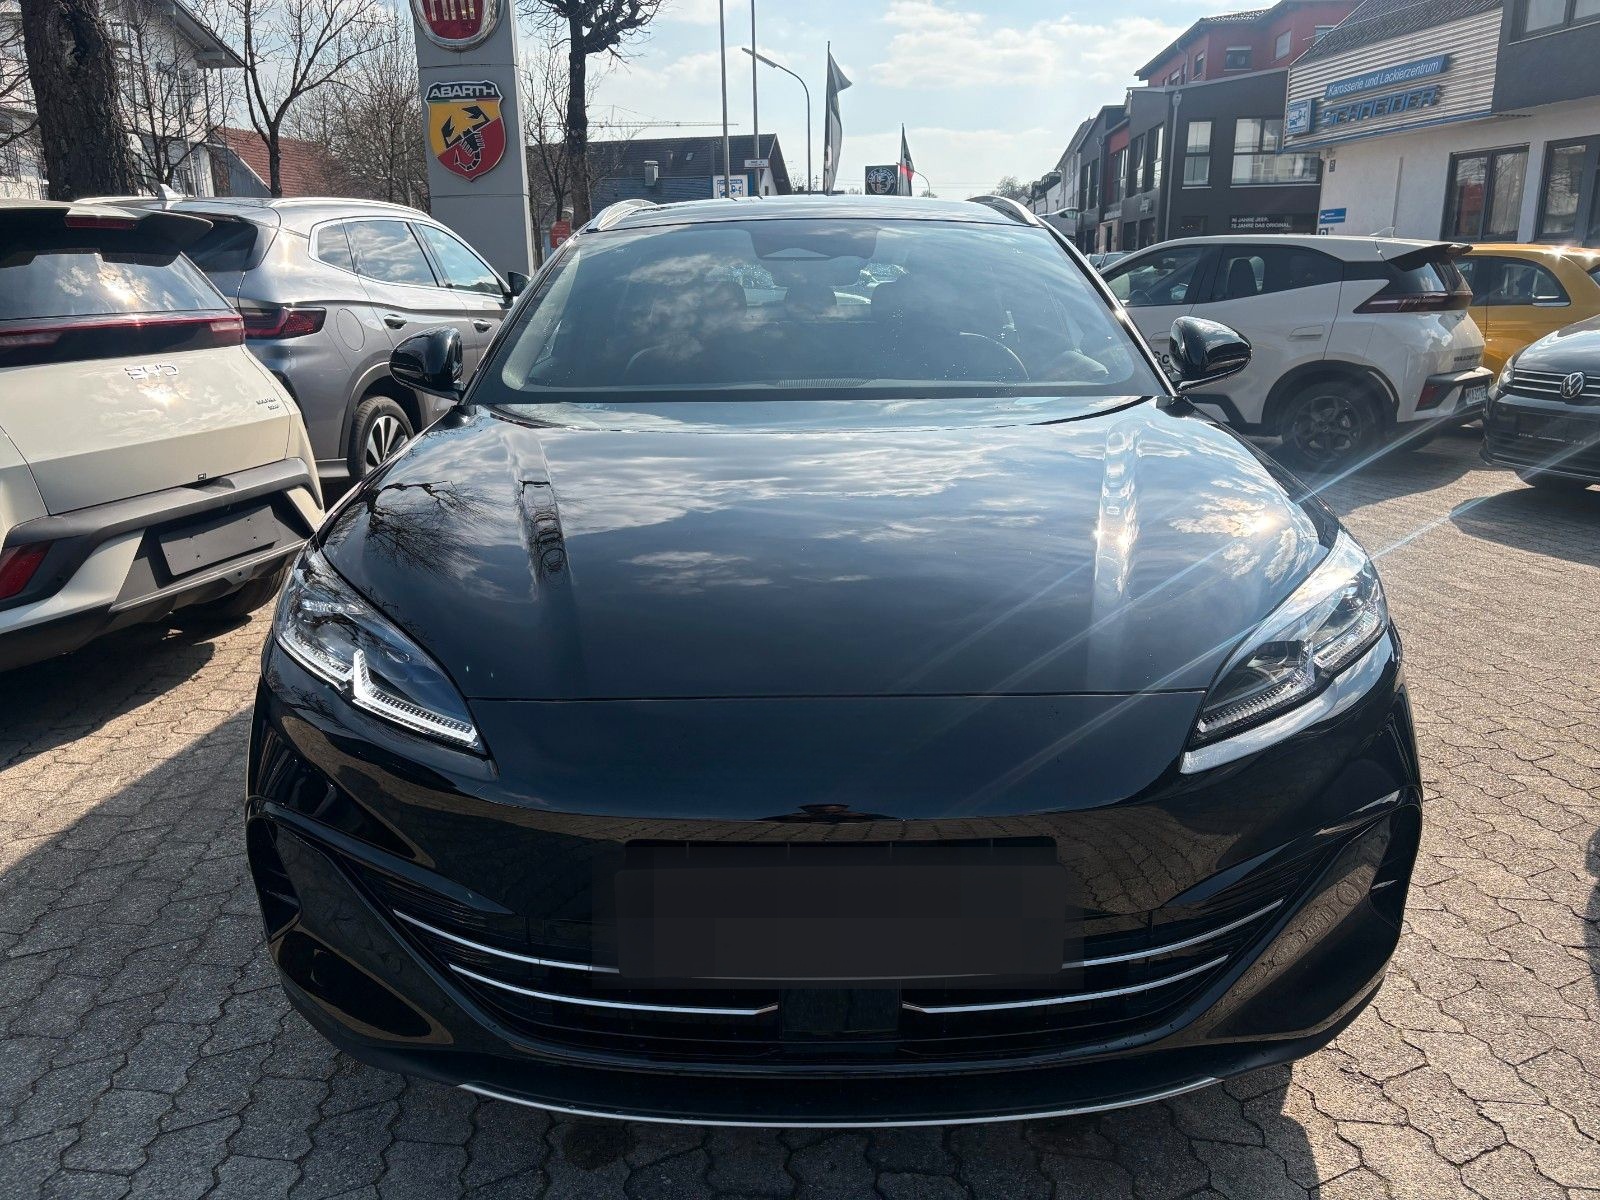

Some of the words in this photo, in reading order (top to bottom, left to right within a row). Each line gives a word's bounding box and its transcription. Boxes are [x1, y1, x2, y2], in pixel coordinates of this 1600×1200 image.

[429, 85, 495, 98] ABARTH
[1327, 78, 1364, 96] Karosserie
[1364, 74, 1380, 88] und
[1380, 60, 1440, 85] Lackierzentrum
[1321, 85, 1440, 126] SCHNEIDER
